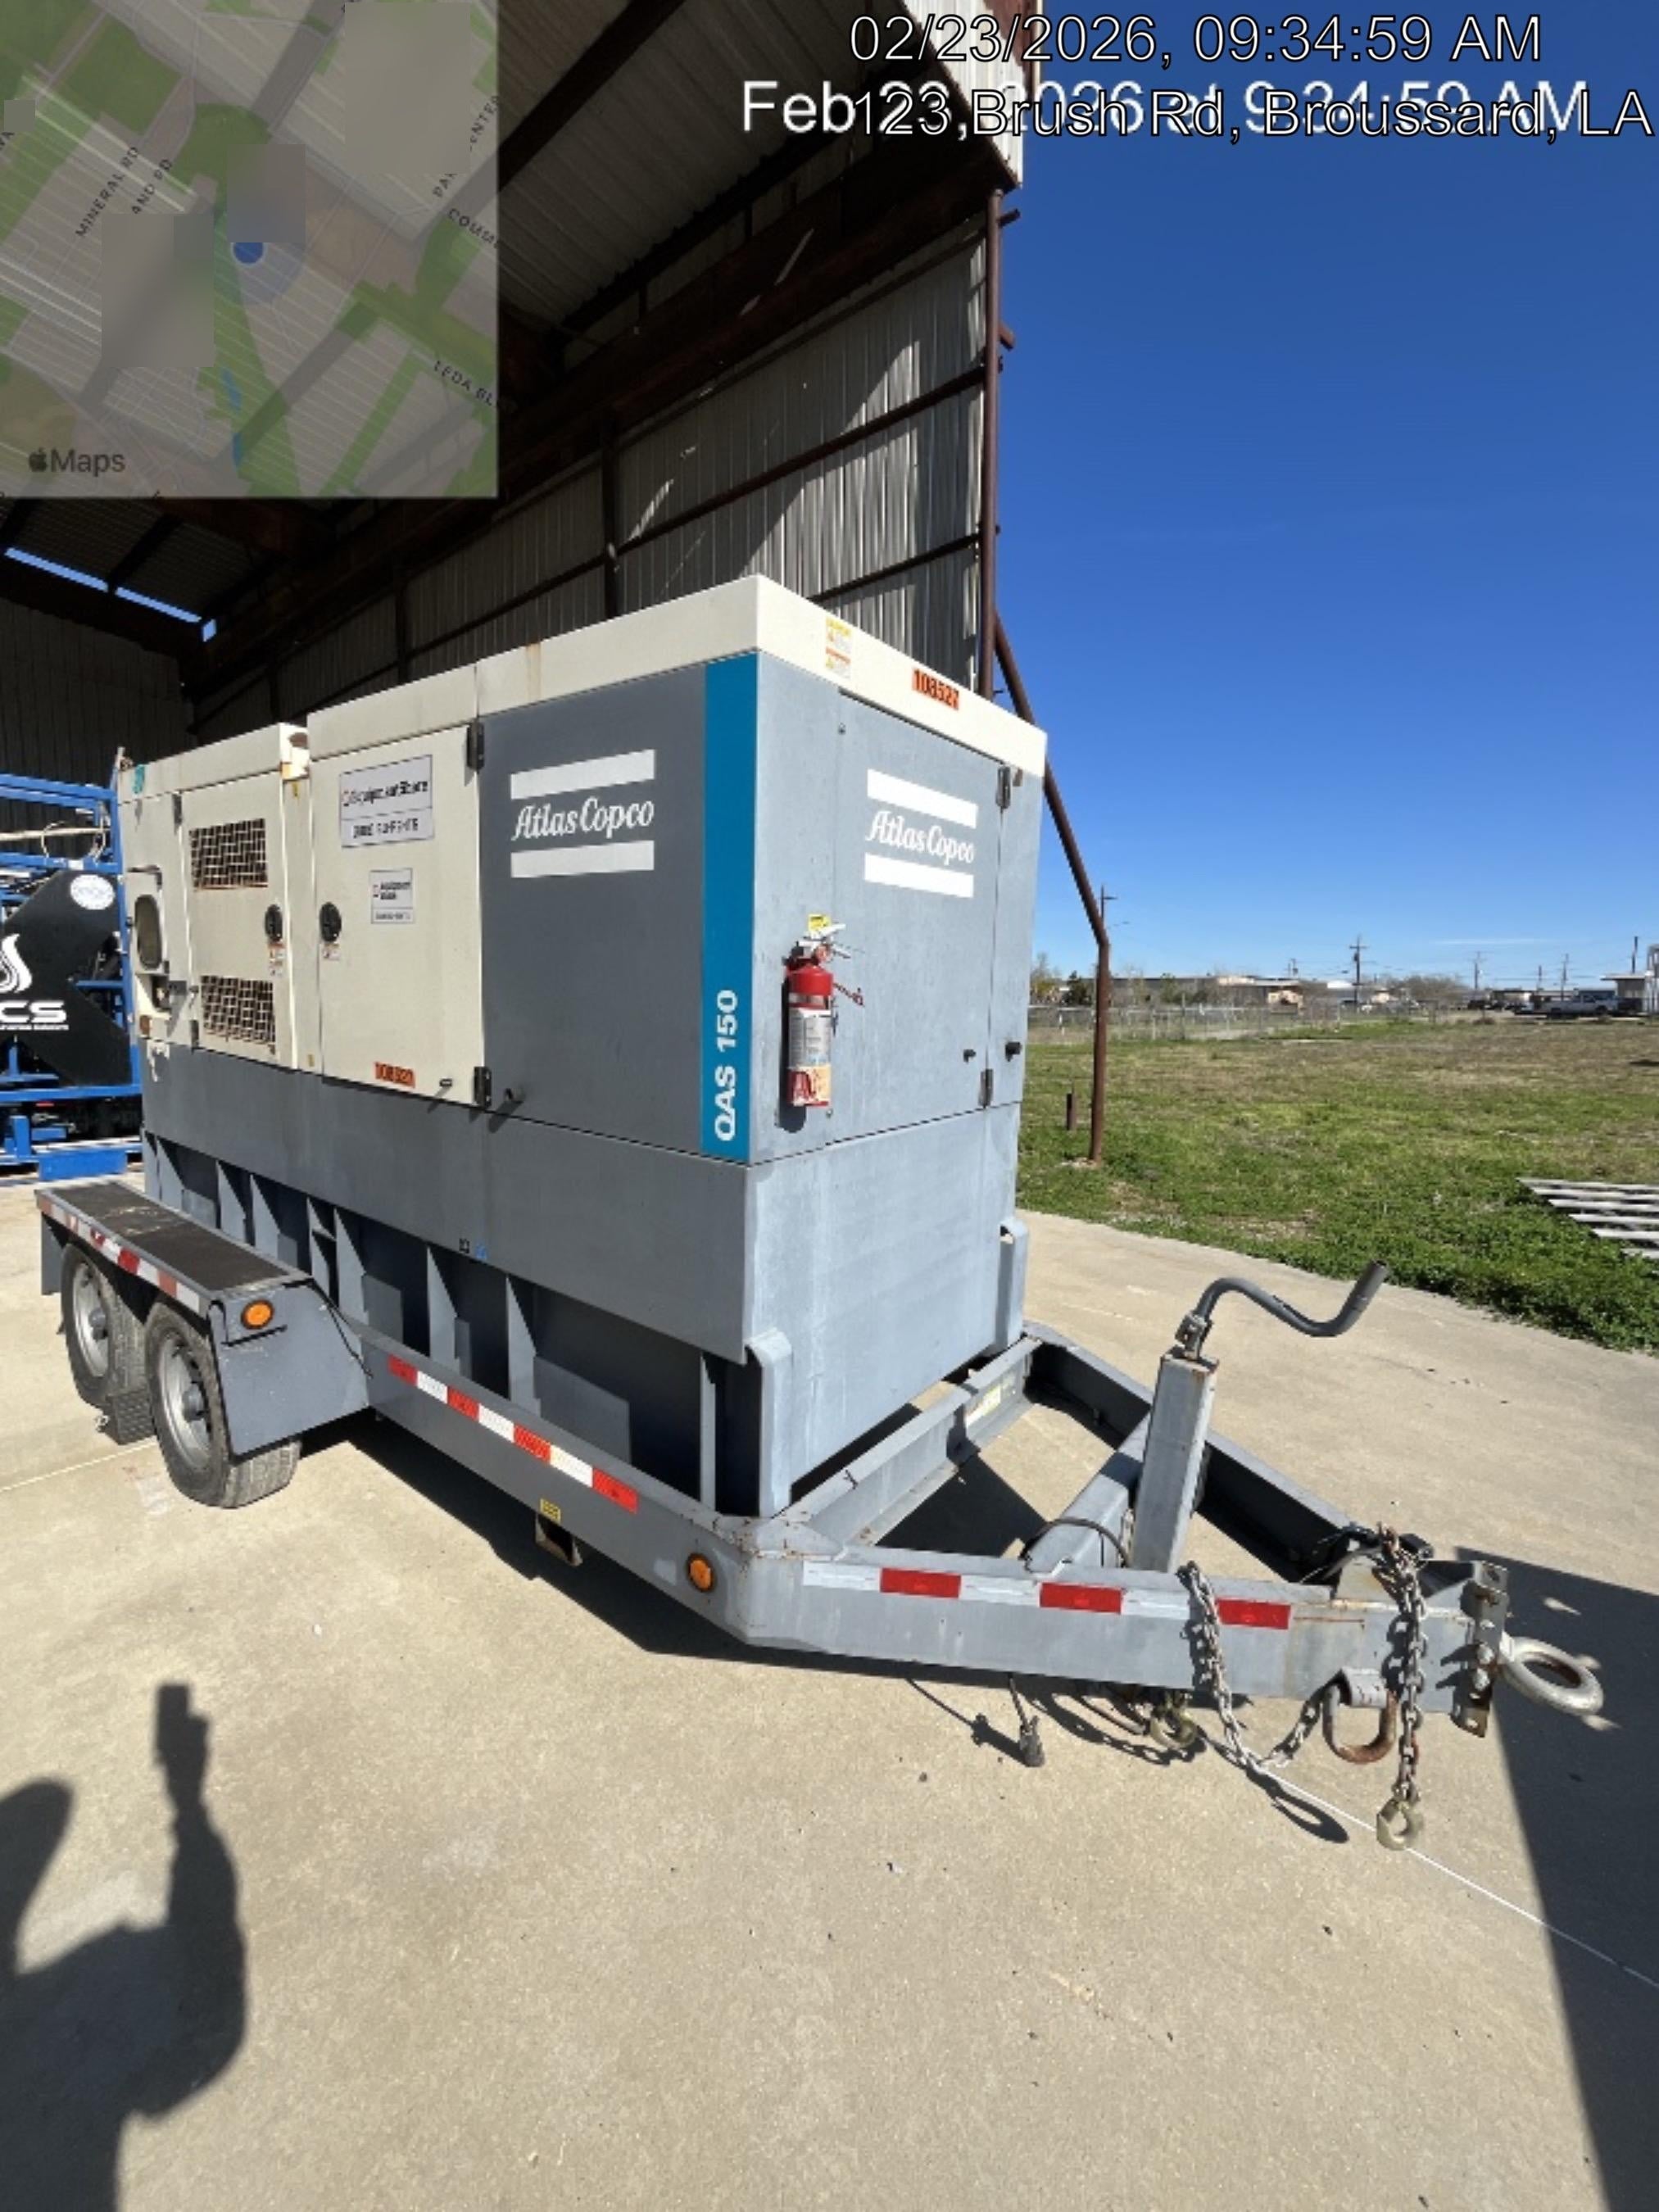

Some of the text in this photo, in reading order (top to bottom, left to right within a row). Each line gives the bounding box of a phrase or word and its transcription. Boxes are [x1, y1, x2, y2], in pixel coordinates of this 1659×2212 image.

[510, 796, 655, 841] Atlas Copco
[865, 809, 975, 866] Atlas Copco
[714, 989, 738, 1142] QAS 150
